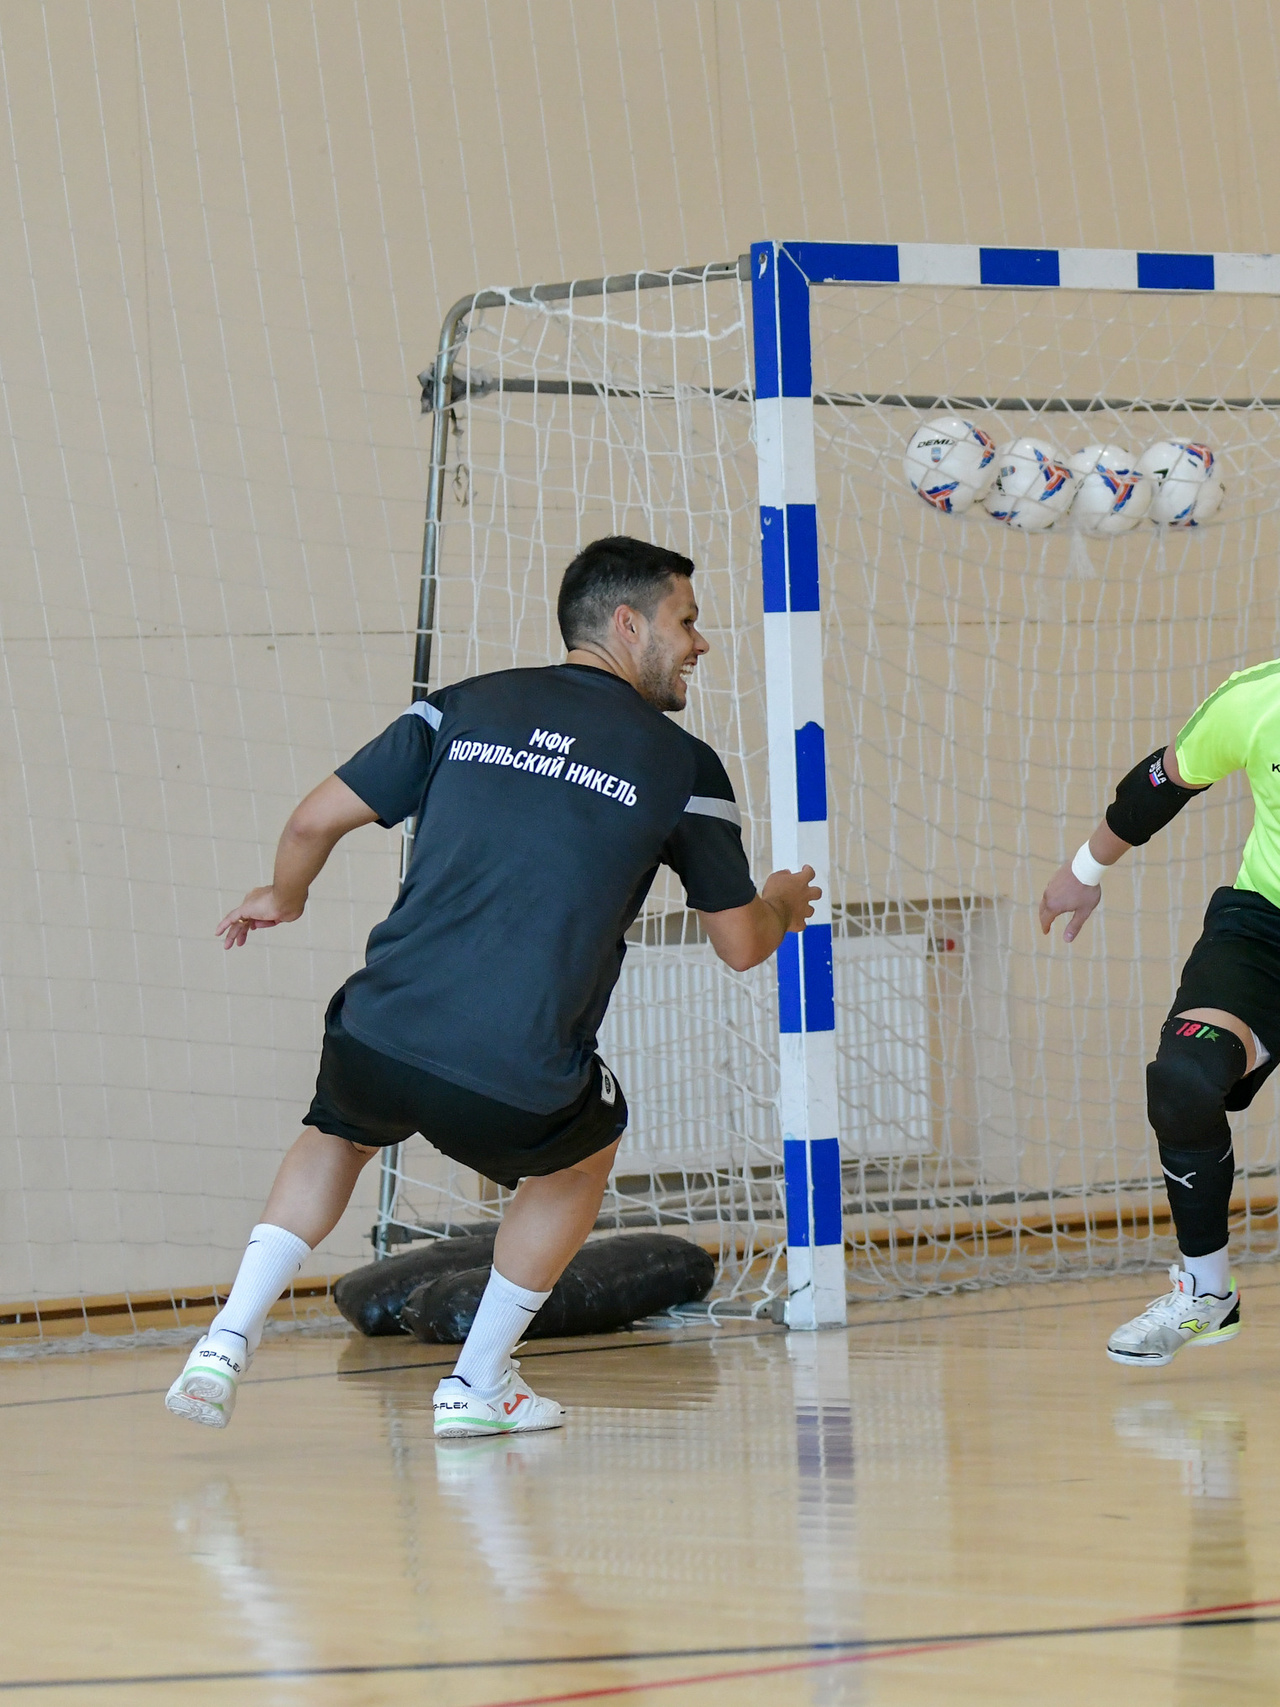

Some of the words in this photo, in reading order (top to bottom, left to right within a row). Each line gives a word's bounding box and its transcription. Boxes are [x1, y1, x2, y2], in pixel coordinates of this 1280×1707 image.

[528, 728, 577, 754] МФК
[448, 739, 566, 779] НОРИЛЬСКИЙ
[564, 763, 638, 808] НИКЕЛЬ
[199, 1350, 241, 1374] TOP-FLE
